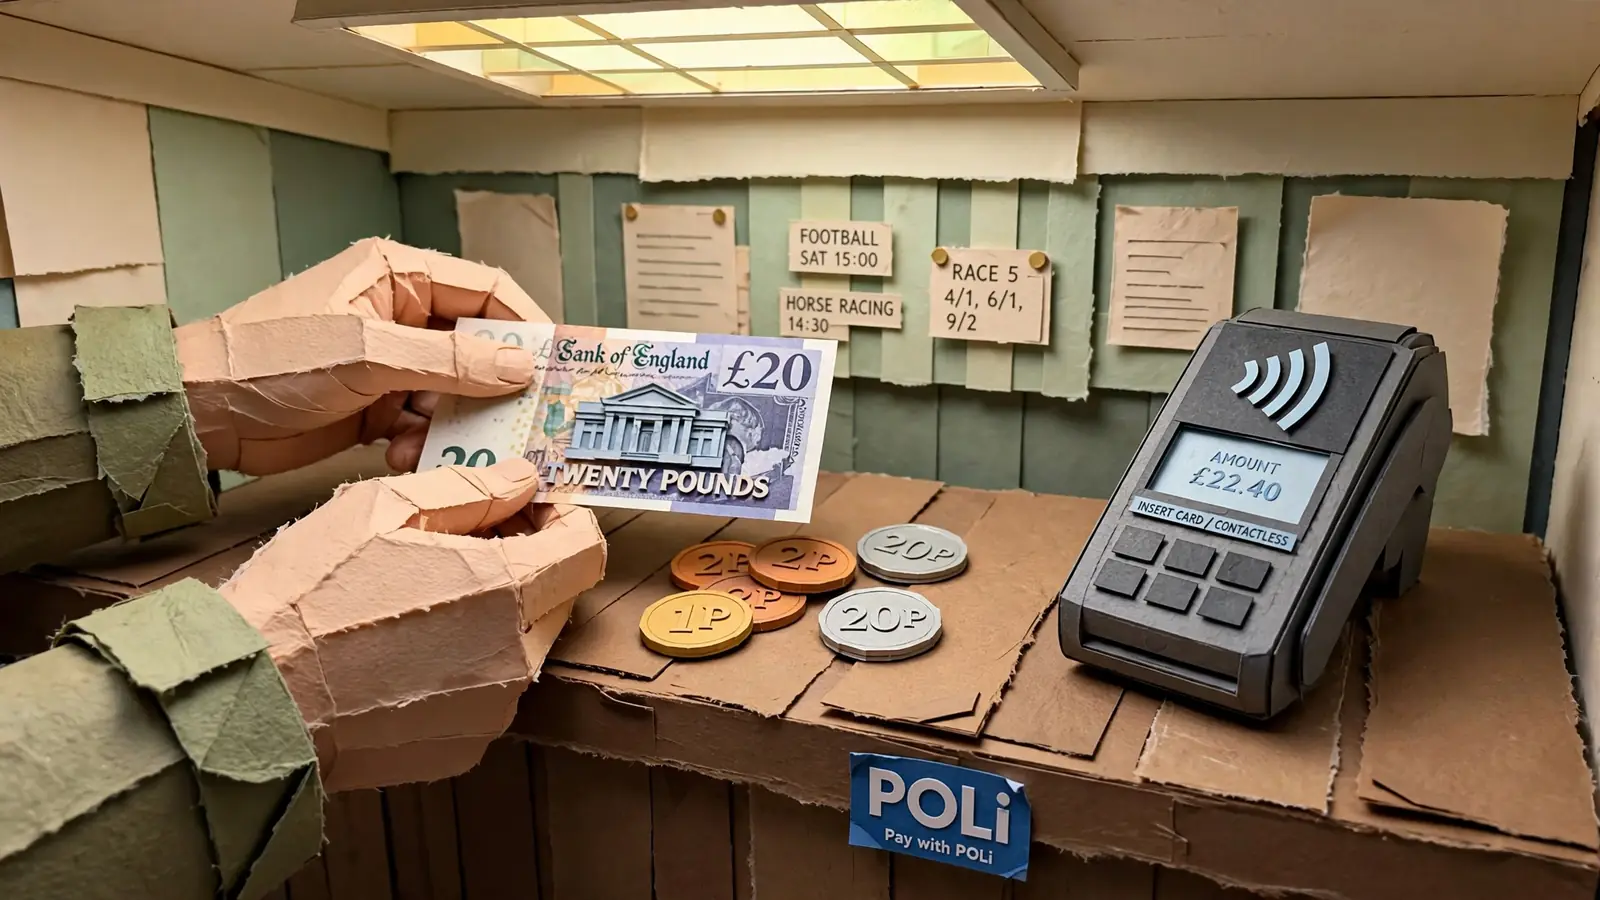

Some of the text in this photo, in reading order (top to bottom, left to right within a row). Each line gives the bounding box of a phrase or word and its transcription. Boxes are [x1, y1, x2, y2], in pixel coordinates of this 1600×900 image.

[800, 228, 879, 246] FOOTBALL
[800, 250, 878, 268] SAT 15:00
[952, 263, 1018, 283] RACE 5
[786, 295, 894, 317] HORSE RACING
[944, 287, 1023, 312] 4/1, 6/1,
[788, 316, 829, 333] 14:30
[946, 311, 977, 332] 9/2
[556, 338, 605, 363] Bank
[610, 346, 631, 369] of
[632, 343, 710, 374] England
[722, 350, 812, 391] £20
[1209, 451, 1281, 475] AMOUNT
[546, 463, 770, 499] TWENTY POUNDS
[1189, 467, 1282, 502] £22.40
[1137, 501, 1175, 518] INSERT
[1175, 510, 1204, 525] CARD
[1214, 519, 1289, 546] CONTACTLESS
[772, 547, 837, 572] 2P
[669, 603, 732, 634] 1P
[840, 606, 927, 633] 20P
[869, 766, 1010, 844] POLi
[884, 828, 993, 865] Pay with POLi
